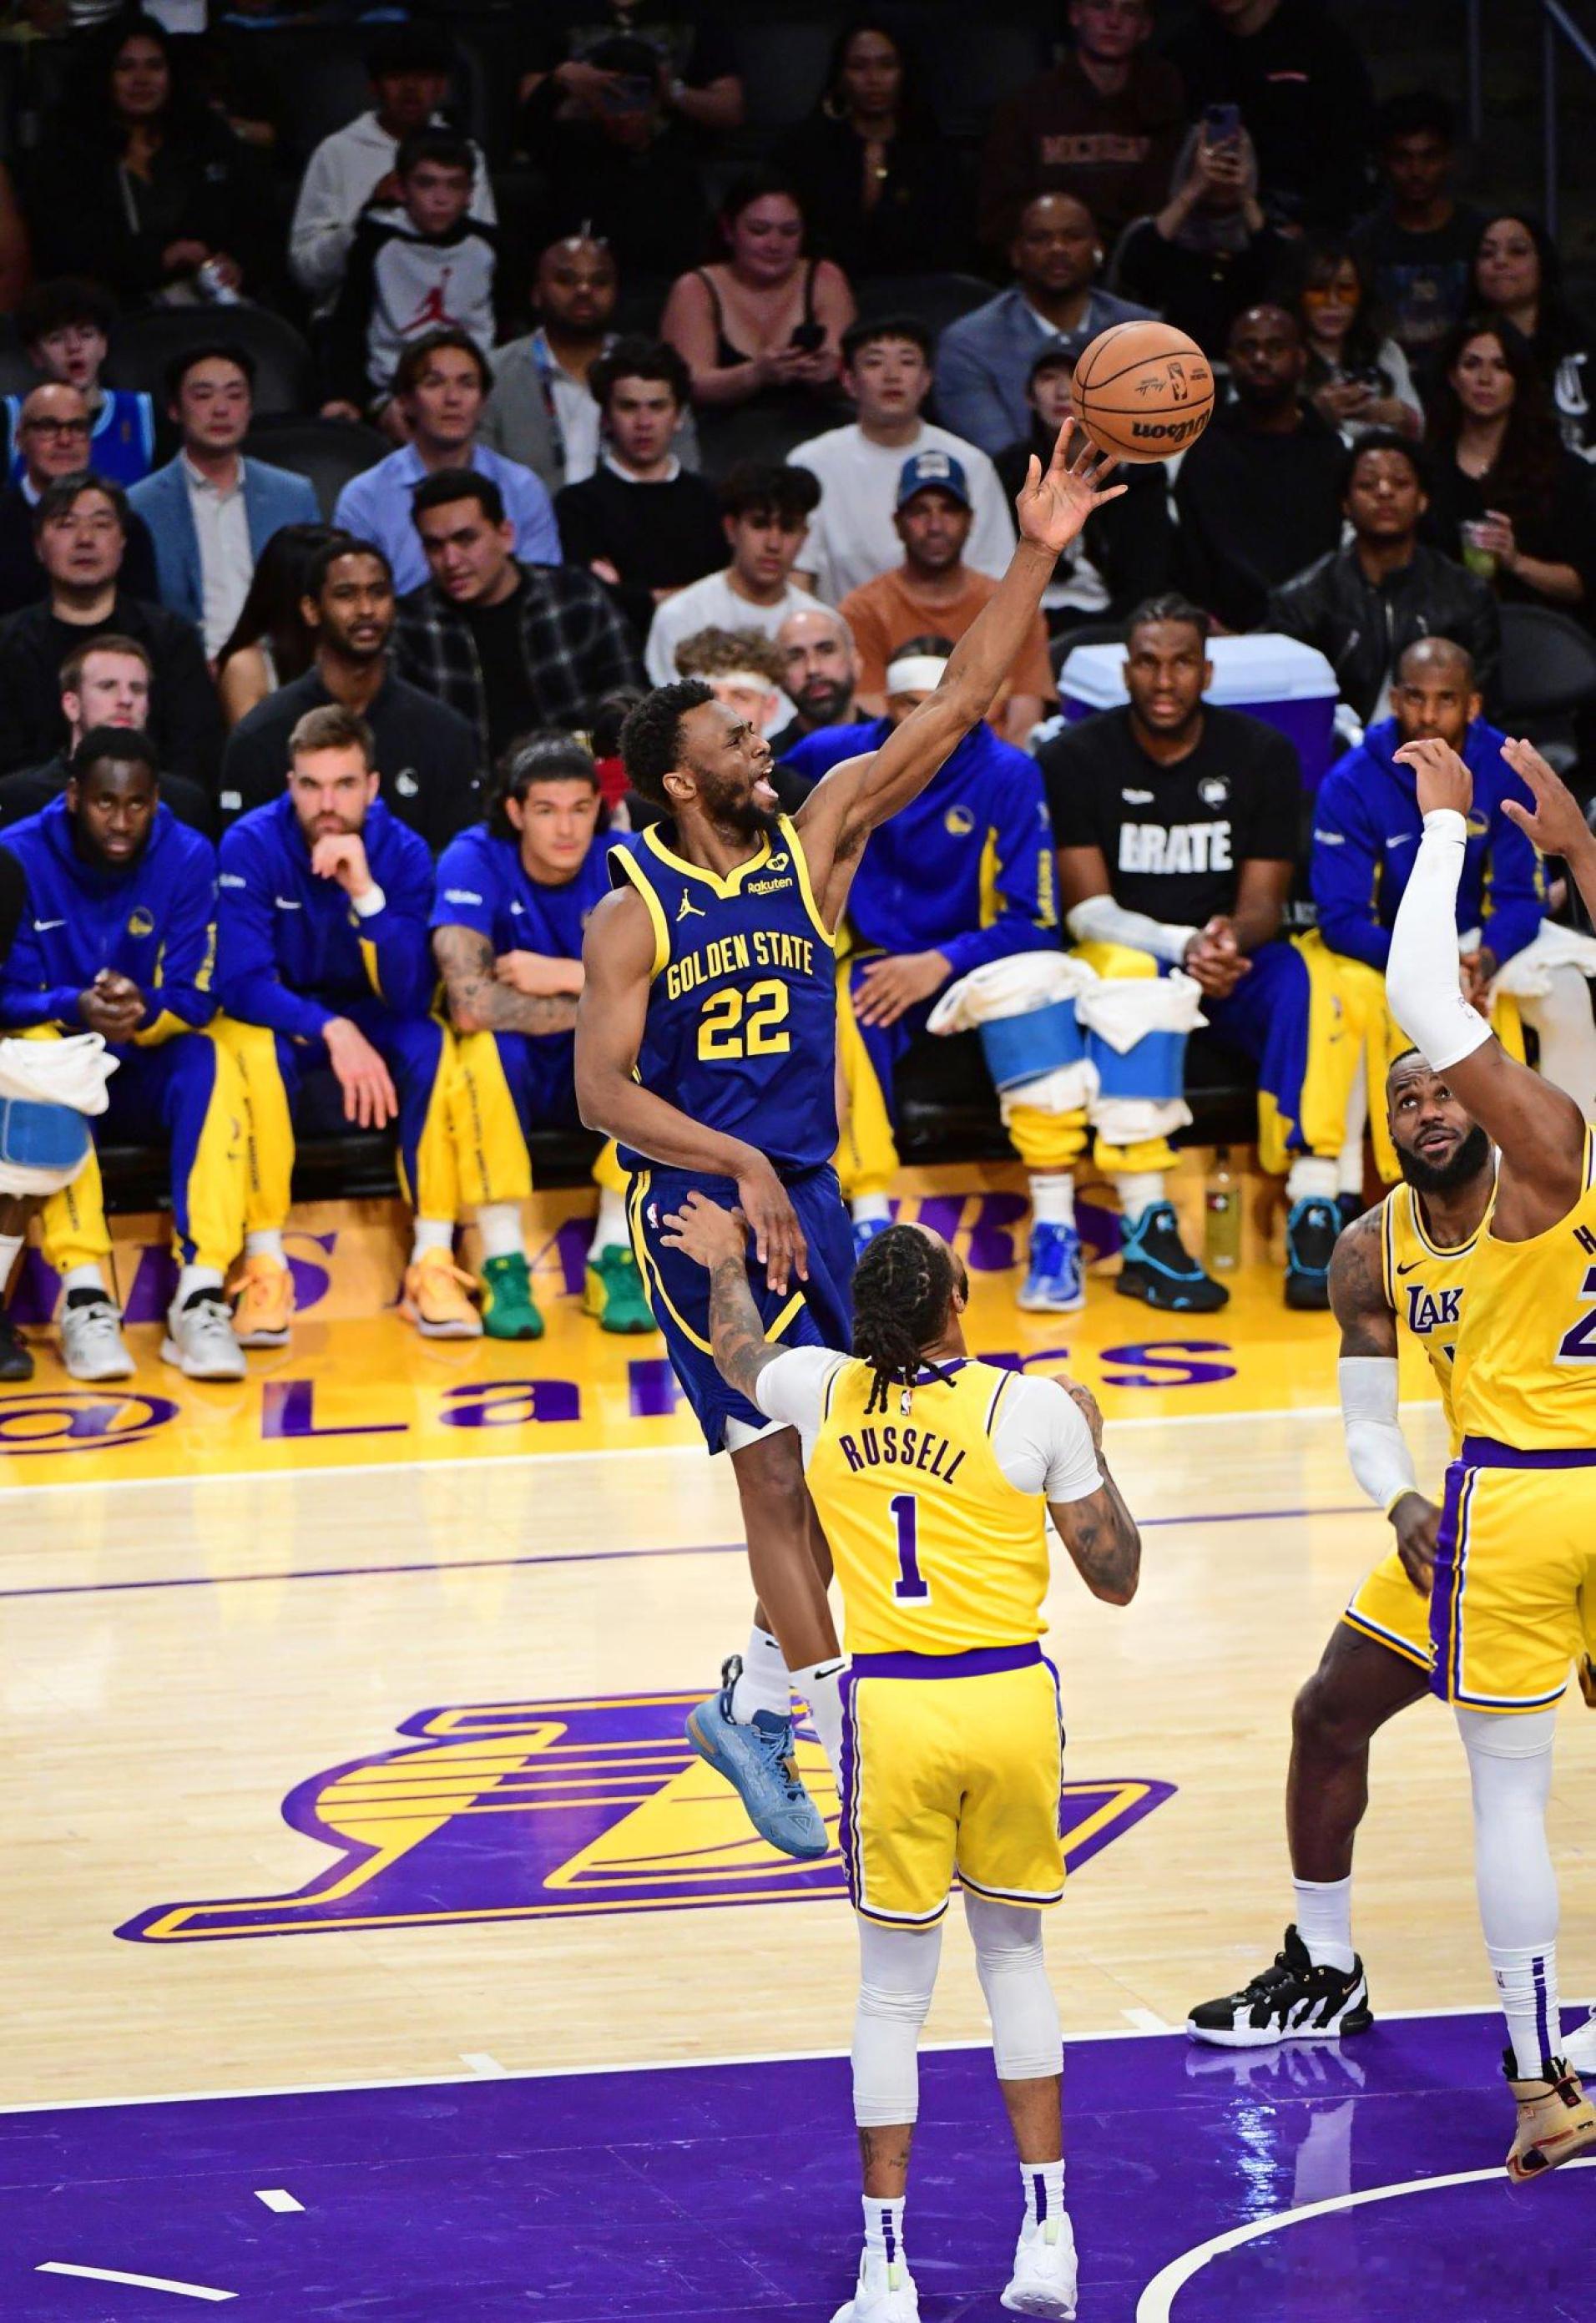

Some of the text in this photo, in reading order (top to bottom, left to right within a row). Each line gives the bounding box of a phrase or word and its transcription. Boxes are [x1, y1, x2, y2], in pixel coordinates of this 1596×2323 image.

[747, 877, 793, 894] Rakuten
[667, 931, 814, 1001] GOLDEN STATE
[698, 978, 790, 1061] 22
[838, 1426, 966, 1485] RUSSELL
[889, 1492, 932, 1608] 1
